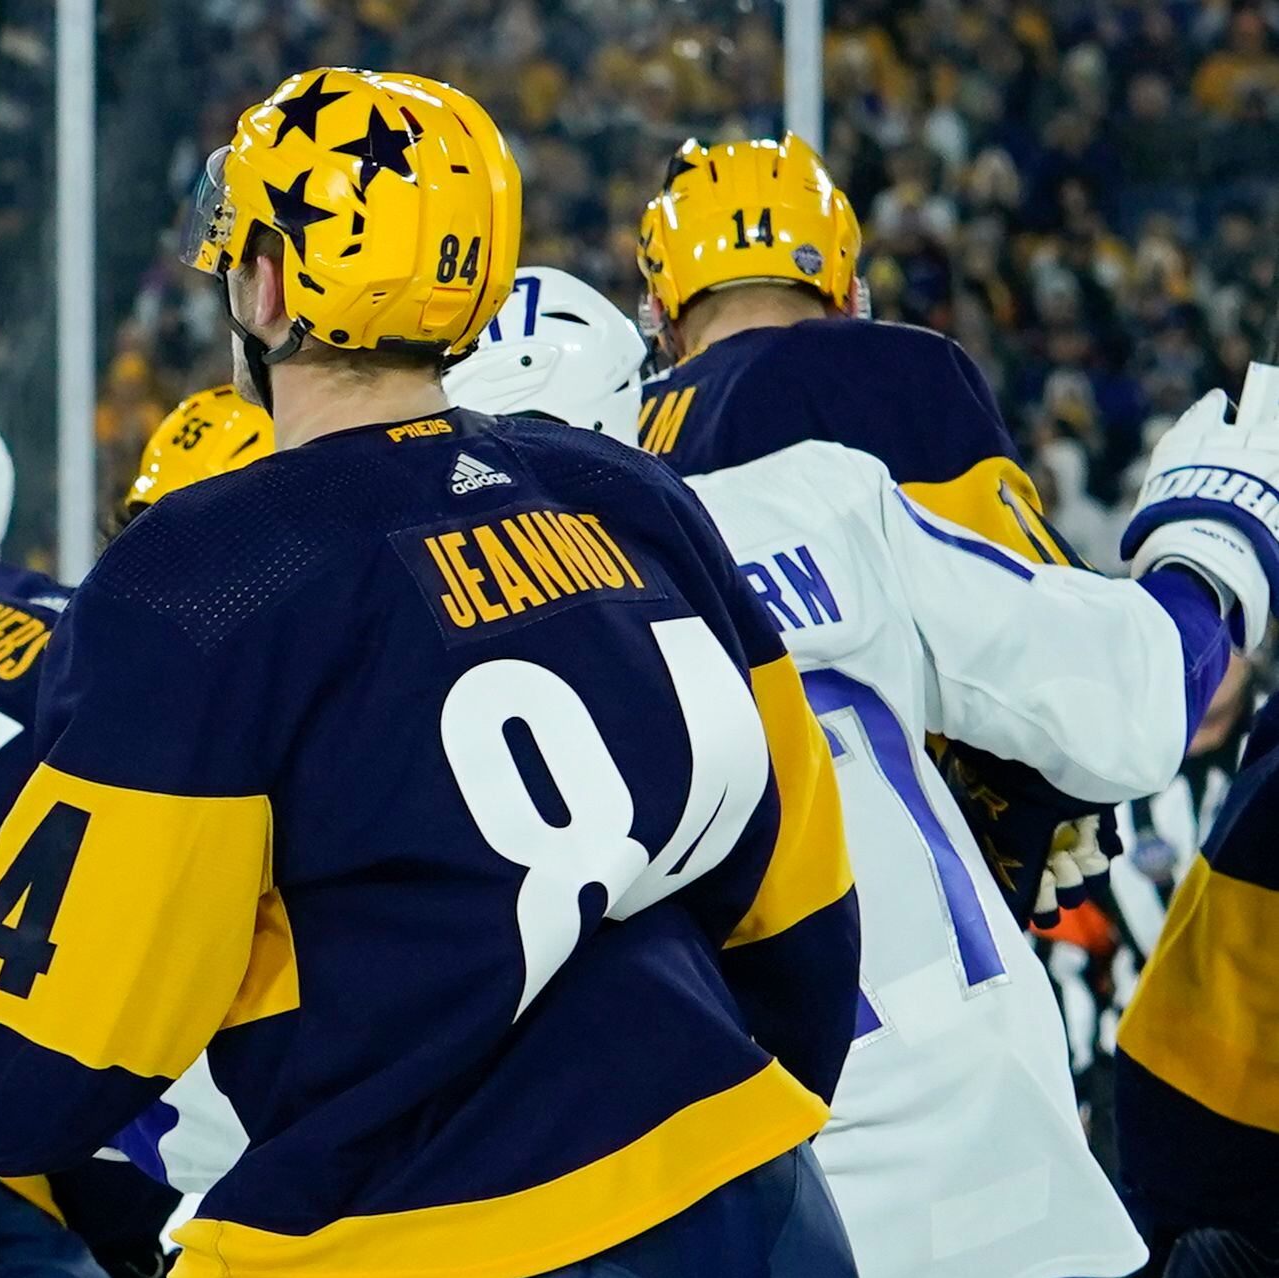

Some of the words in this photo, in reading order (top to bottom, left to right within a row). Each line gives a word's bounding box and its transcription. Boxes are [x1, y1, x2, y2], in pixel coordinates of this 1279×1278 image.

[731, 207, 774, 250] 14
[436, 233, 481, 285] 84
[172, 416, 213, 451] 55
[386, 418, 453, 443] PREDS
[452, 468, 512, 495] adidas
[424, 511, 644, 629] JEANNOT
[442, 616, 770, 1023] 84
